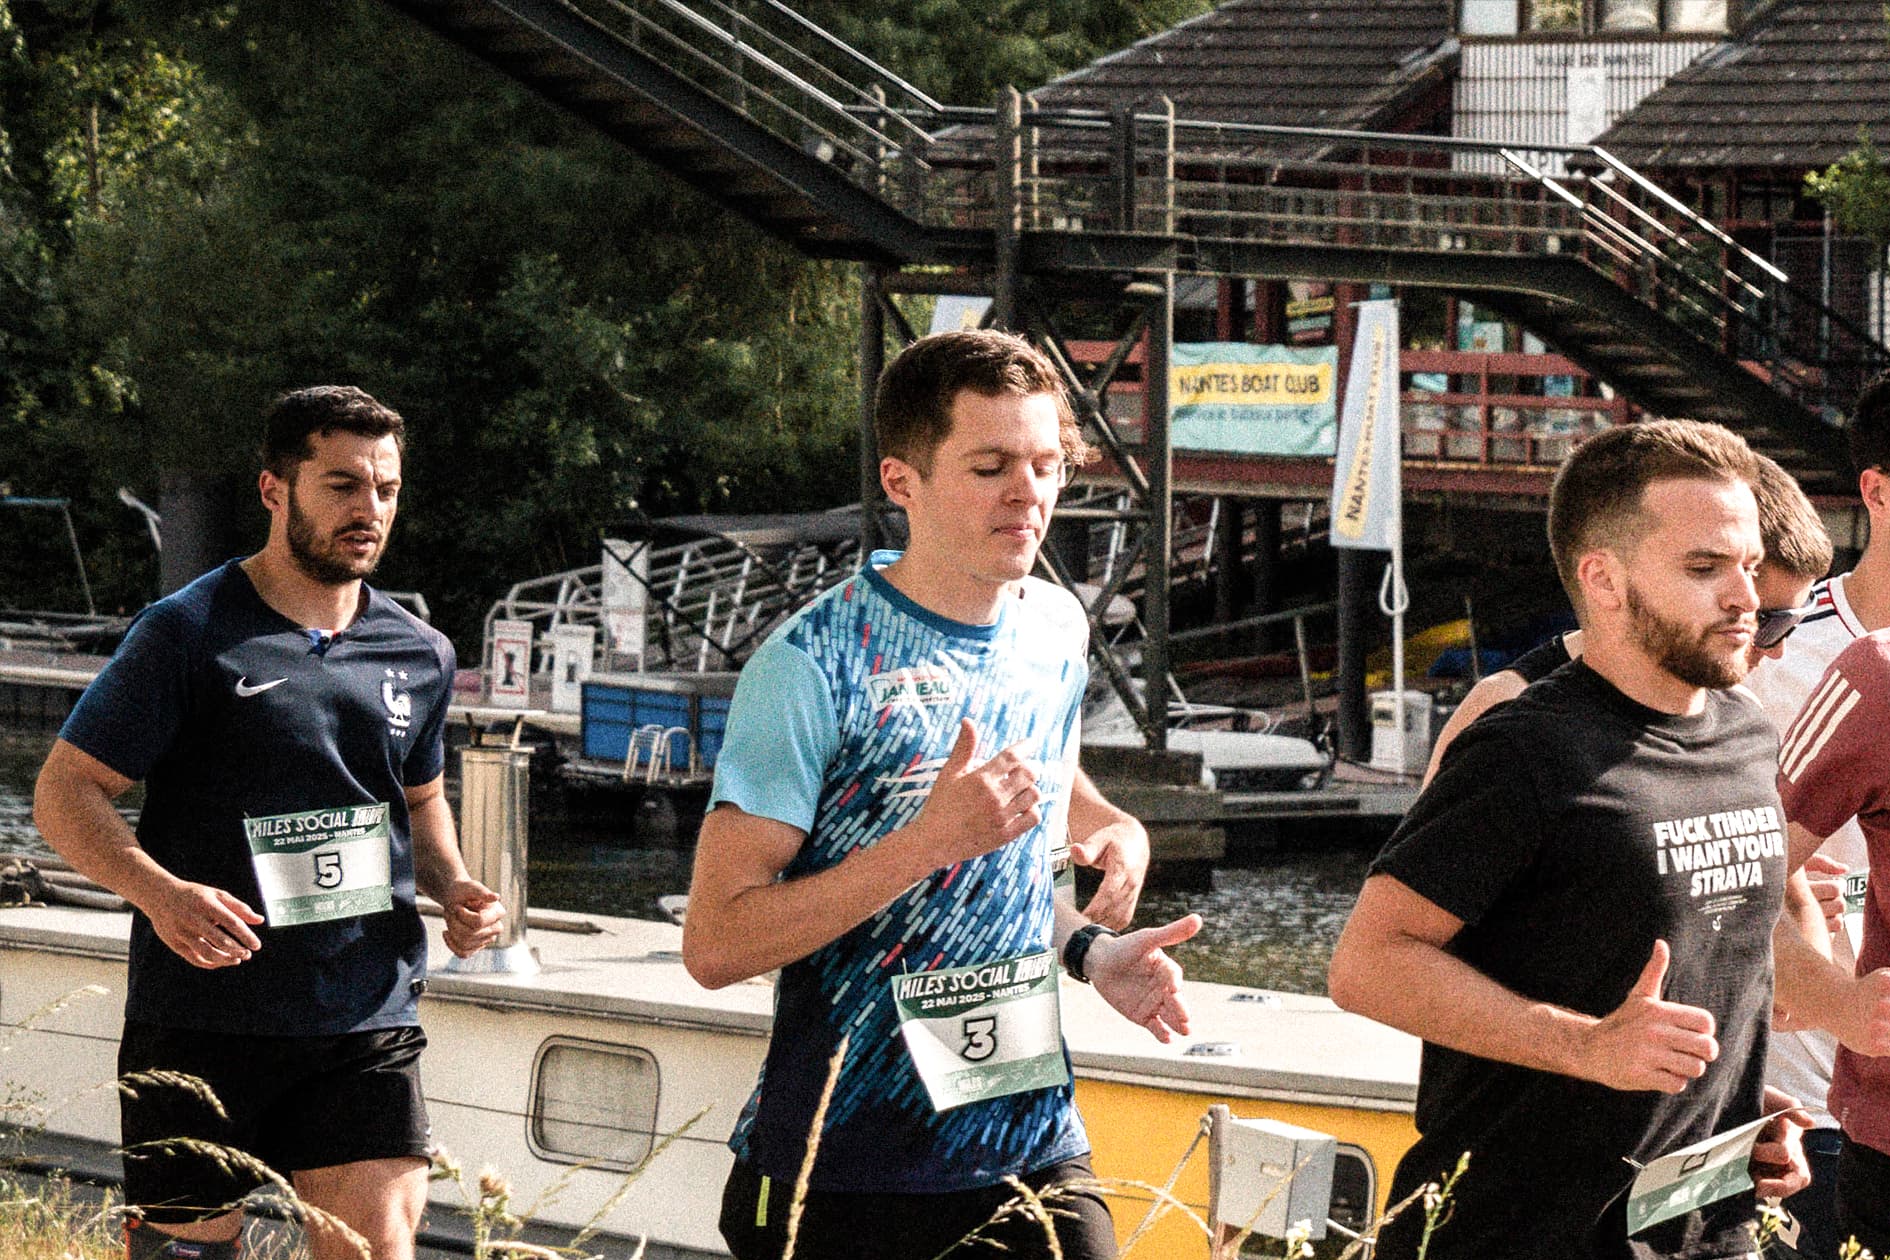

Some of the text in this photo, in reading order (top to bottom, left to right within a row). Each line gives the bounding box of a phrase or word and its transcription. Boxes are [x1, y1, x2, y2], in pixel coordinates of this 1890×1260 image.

[1179, 374, 1320, 393] NANTES BOAT CLUB
[1344, 447, 1371, 521] NANTES
[879, 681, 950, 703] JANEAU
[252, 818, 292, 838] MILES
[296, 811, 349, 833] SOCIAL
[273, 838, 286, 846] 22
[1653, 806, 1780, 847] FUCK TINDER
[314, 852, 343, 889] 5
[1657, 831, 1784, 874] I WANT YOUR
[1690, 861, 1764, 897] STRAVA
[900, 975, 947, 1000] MILES
[949, 964, 1011, 993] SOCIAL
[921, 1000, 936, 1009] 22
[961, 1016, 998, 1062] 3
